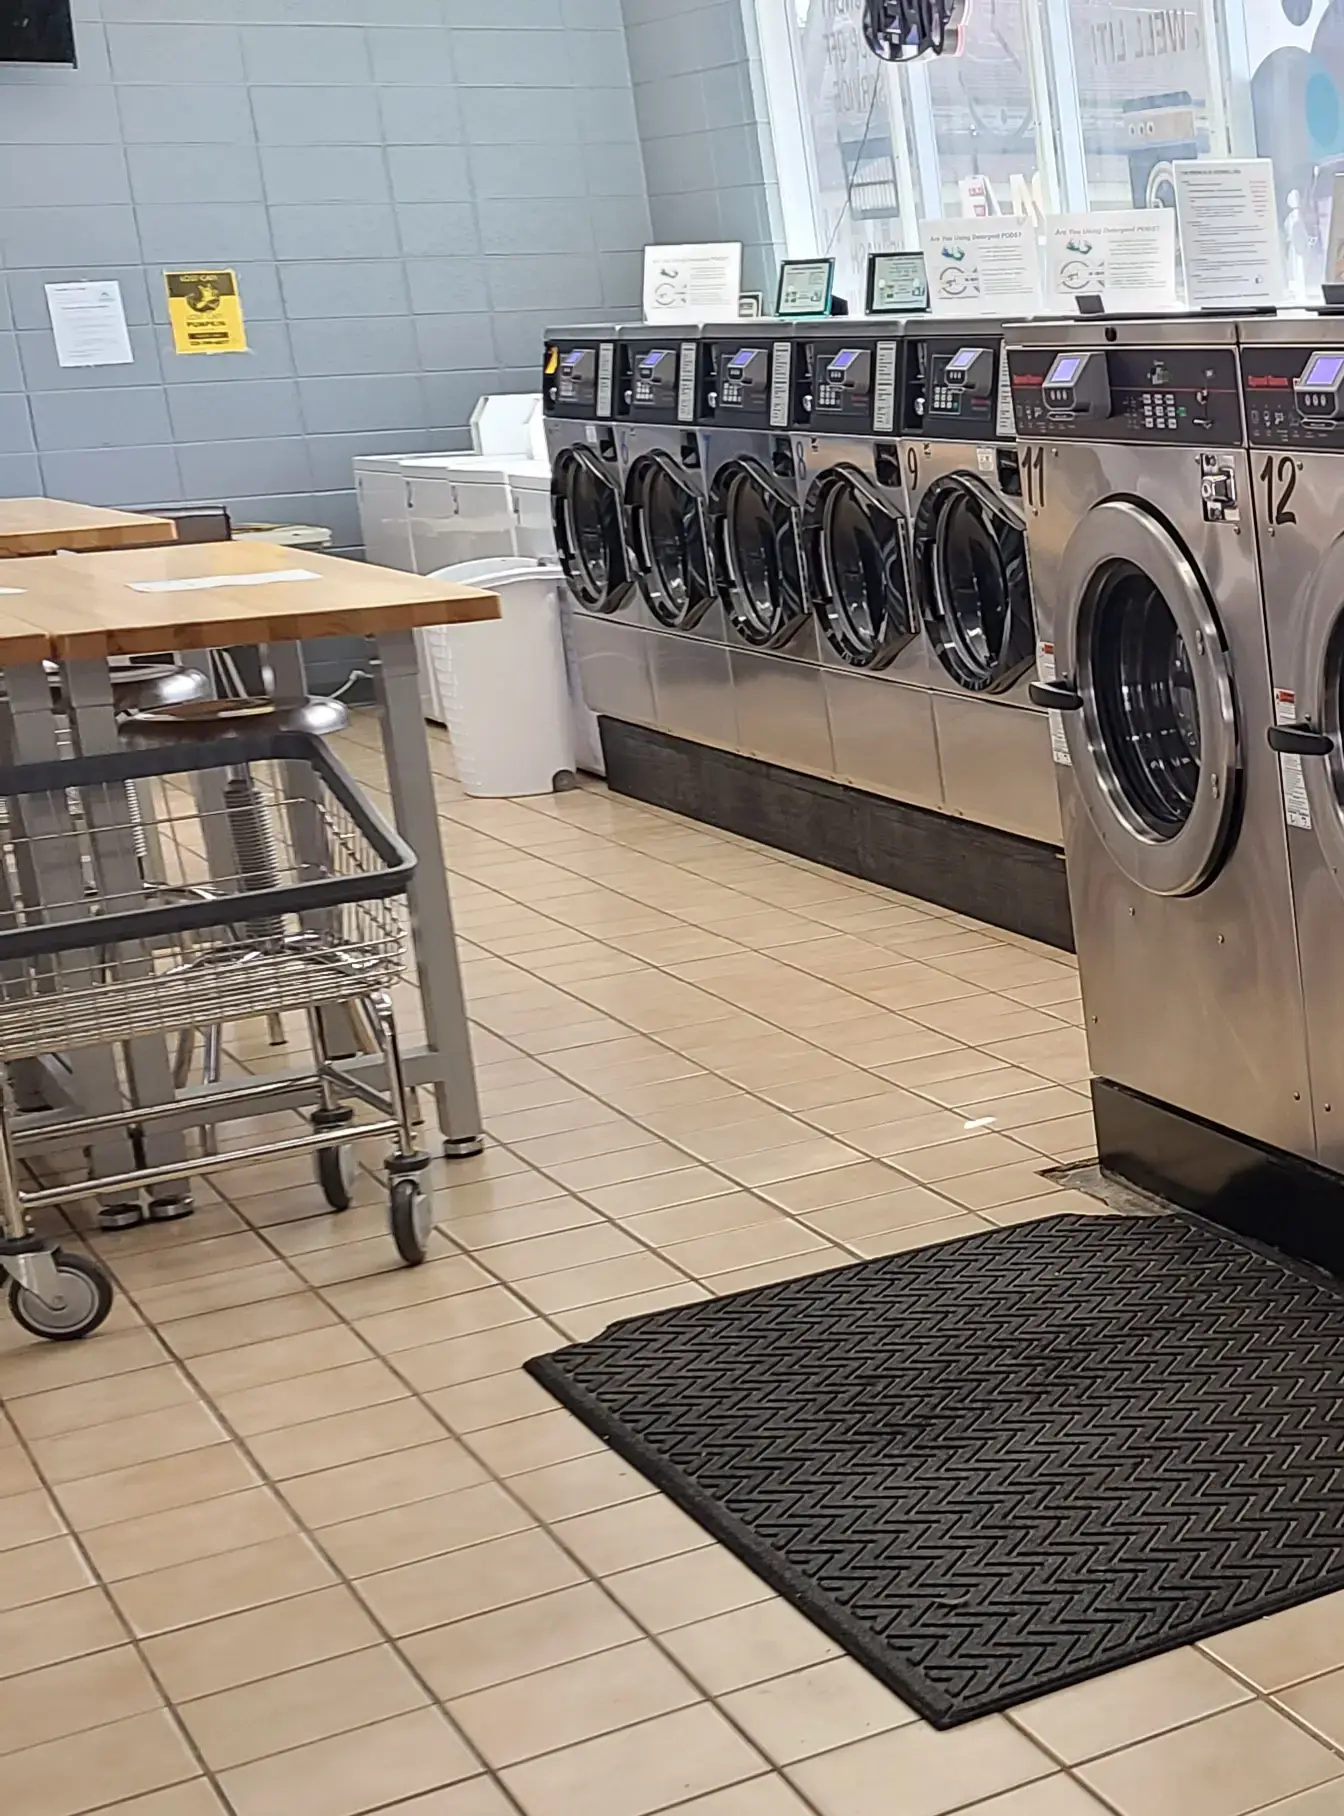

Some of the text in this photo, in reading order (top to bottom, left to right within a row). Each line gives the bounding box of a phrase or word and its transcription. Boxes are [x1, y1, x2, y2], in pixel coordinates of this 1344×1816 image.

[796, 440, 807, 481] 8
[907, 446, 919, 492] 9
[1021, 445, 1045, 508] 11
[1260, 454, 1298, 525] 12
